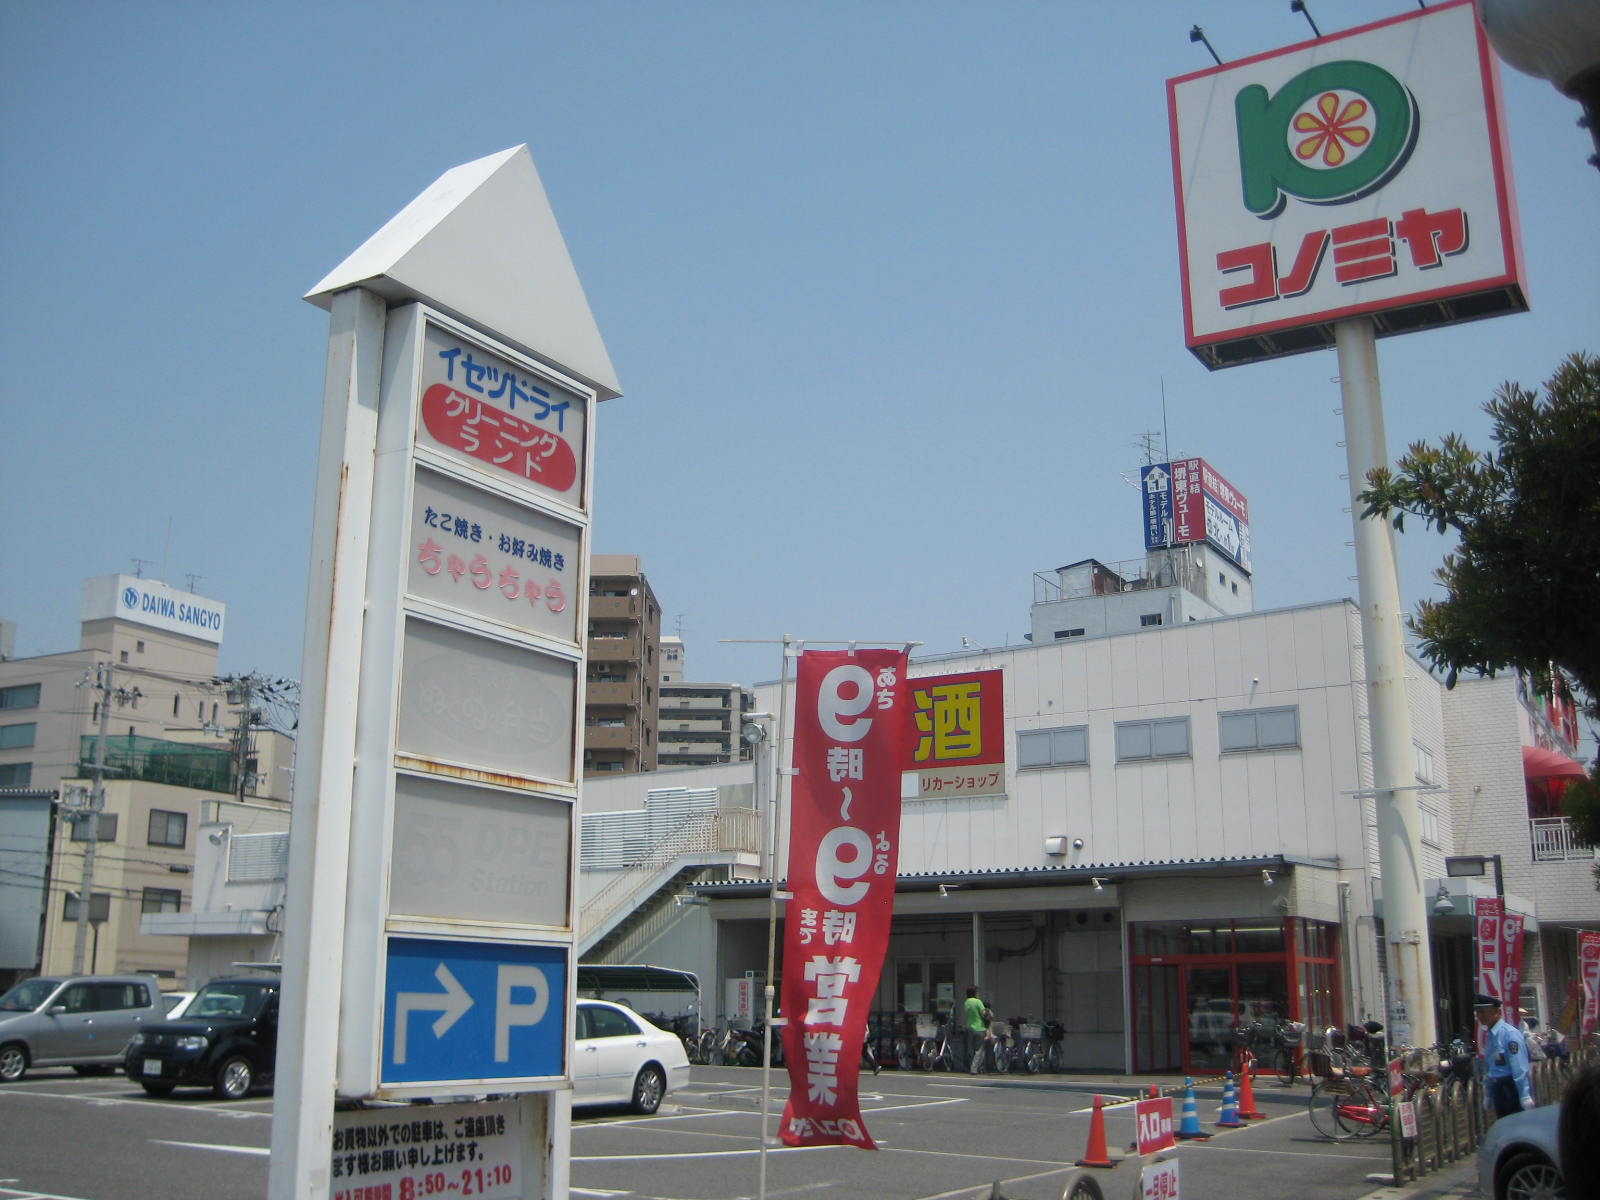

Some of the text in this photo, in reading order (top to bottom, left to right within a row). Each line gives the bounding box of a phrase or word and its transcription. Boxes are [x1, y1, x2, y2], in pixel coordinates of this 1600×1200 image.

[1216, 207, 1470, 310] コノミヤ
[445, 391, 558, 458] クリーニング
[459, 424, 543, 478] ランド
[424, 506, 565, 571] たこ焼き・お好み焼き
[418, 538, 567, 612] ちゃうちゃう
[142, 592, 221, 631] DAIWA SANGYO
[912, 680, 983, 762] 酒
[922, 771, 1000, 791] リカーショップ
[494, 964, 550, 1062] P
